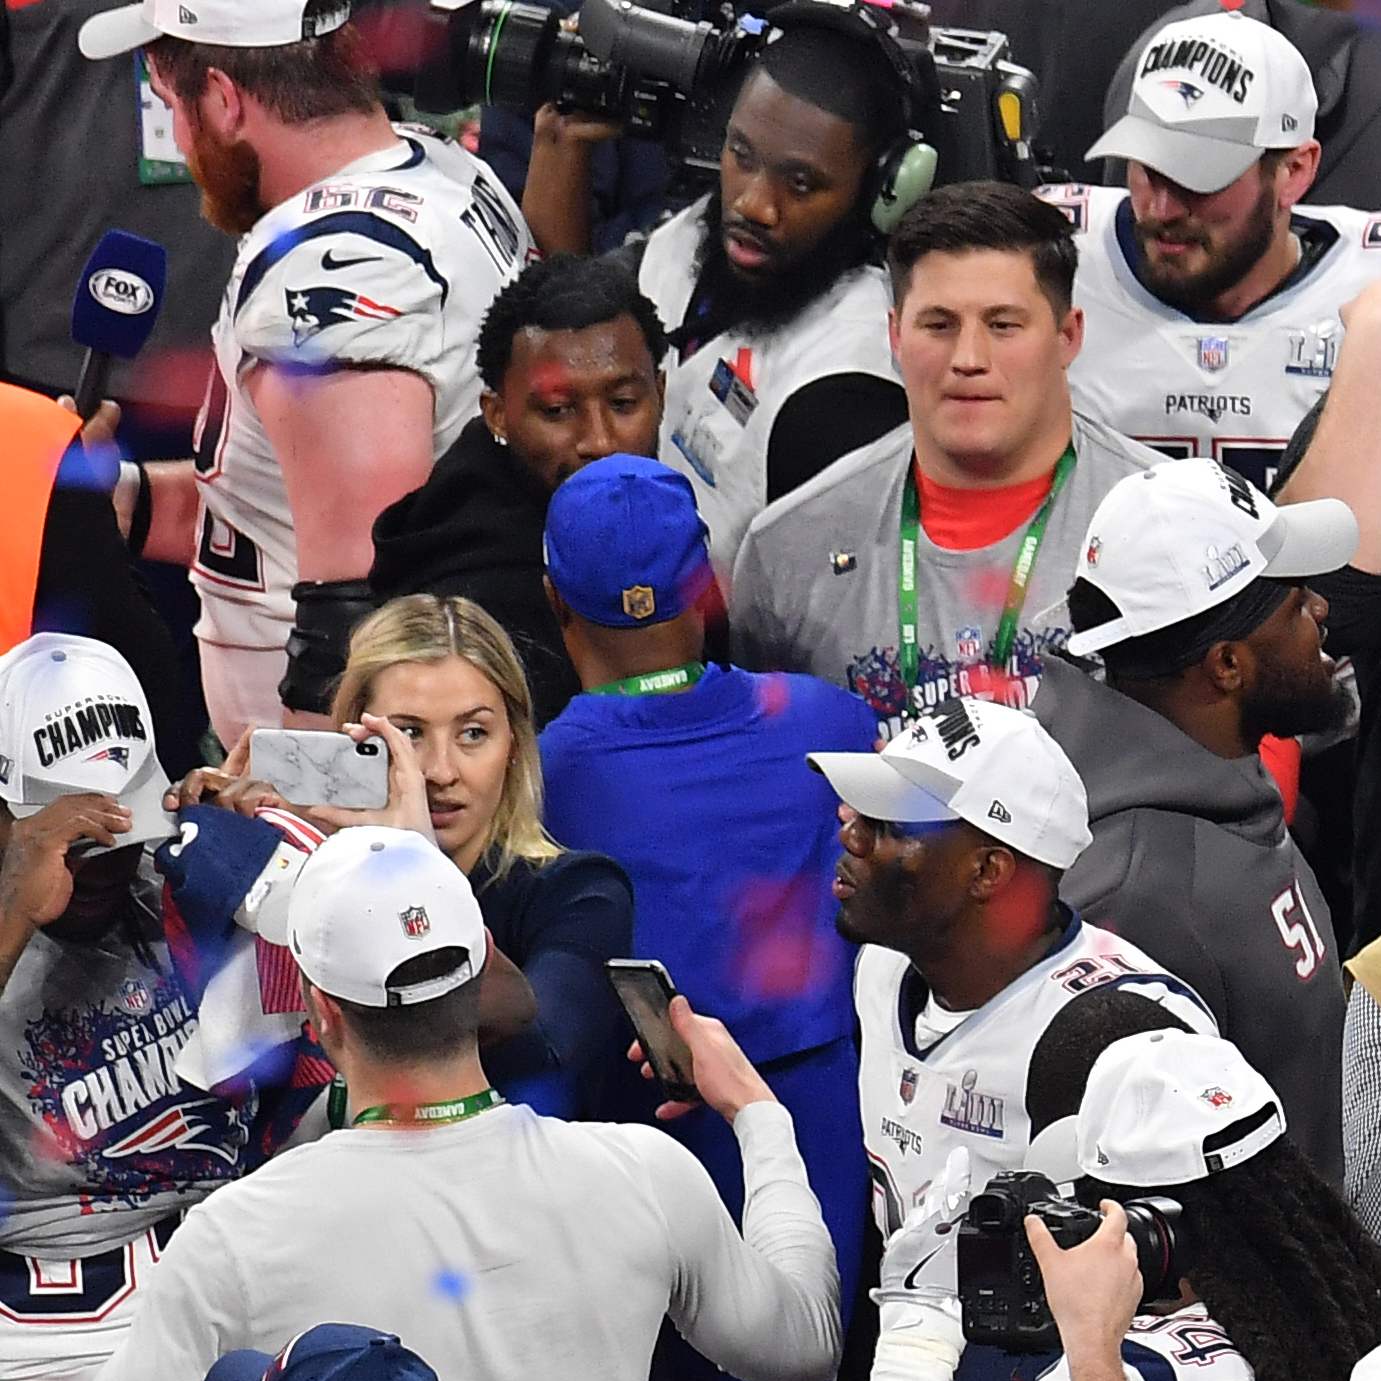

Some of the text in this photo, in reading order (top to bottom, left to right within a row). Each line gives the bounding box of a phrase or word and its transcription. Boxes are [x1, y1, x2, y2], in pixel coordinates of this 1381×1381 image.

[103, 276, 141, 302] FOX
[1165, 394, 1252, 417] PATRIOTS
[103, 1027, 153, 1062] SUPER
